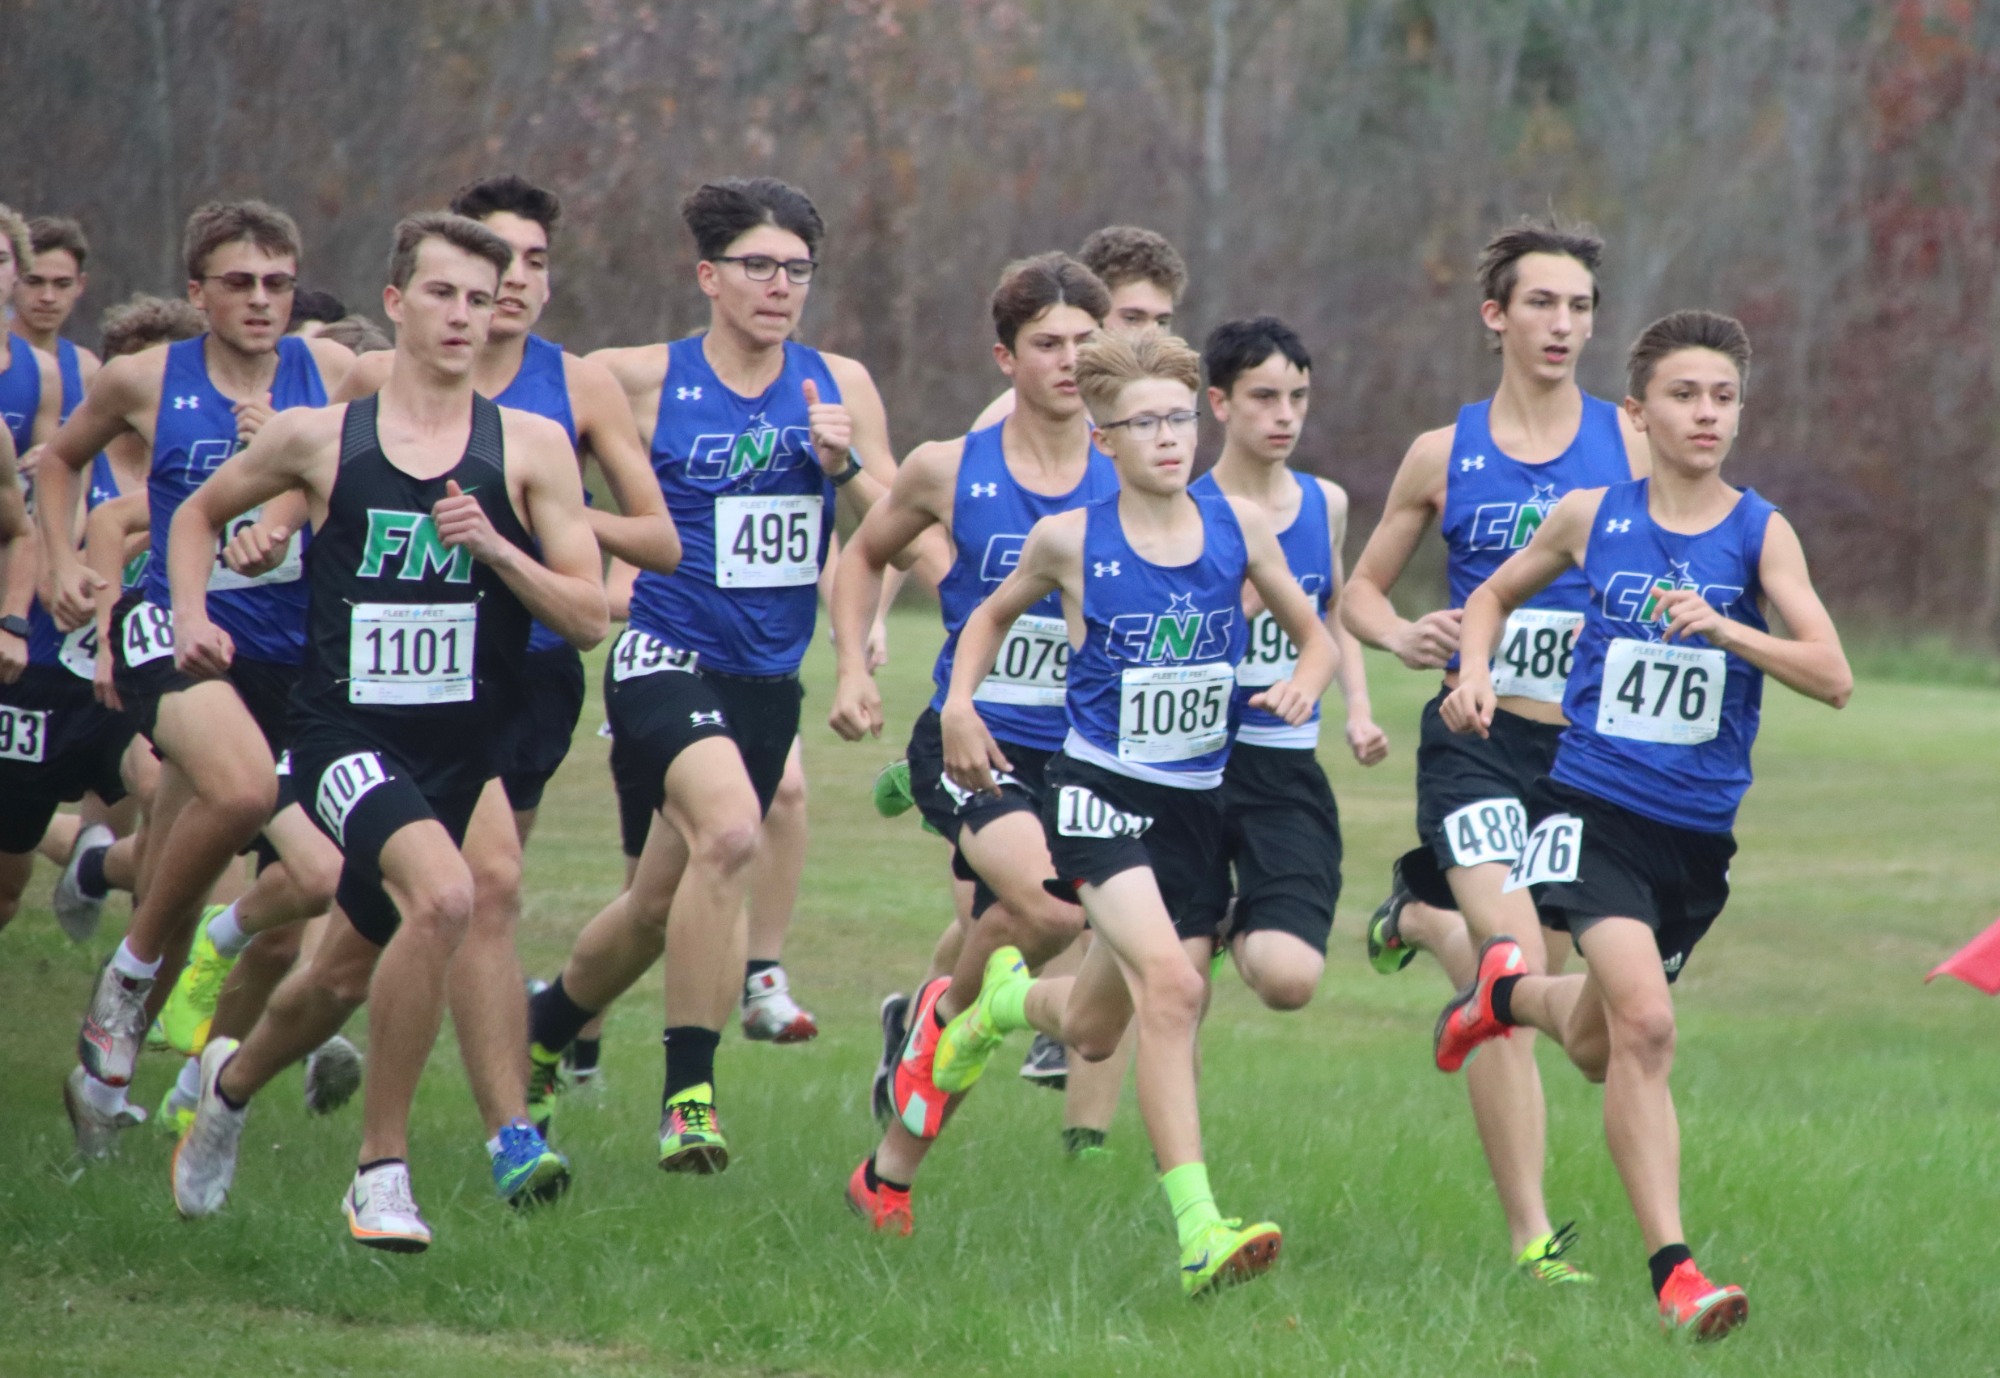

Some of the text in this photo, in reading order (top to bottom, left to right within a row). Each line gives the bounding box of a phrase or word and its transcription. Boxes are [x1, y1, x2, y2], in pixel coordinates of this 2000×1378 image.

[685, 426, 811, 480] CNS
[356, 509, 473, 584] FM
[732, 512, 808, 564] 495
[1469, 502, 1559, 551] CN
[383, 609, 445, 618] FLEET FEET
[1105, 606, 1235, 663] CNS
[365, 627, 460, 675] 1101
[1152, 671, 1208, 680] FLEET FEET
[1505, 627, 1574, 679] 488
[1634, 646, 1702, 662] FLEET FEET
[1130, 685, 1223, 735] 1085
[1616, 659, 1709, 721] 476
[1458, 805, 1525, 856] 488
